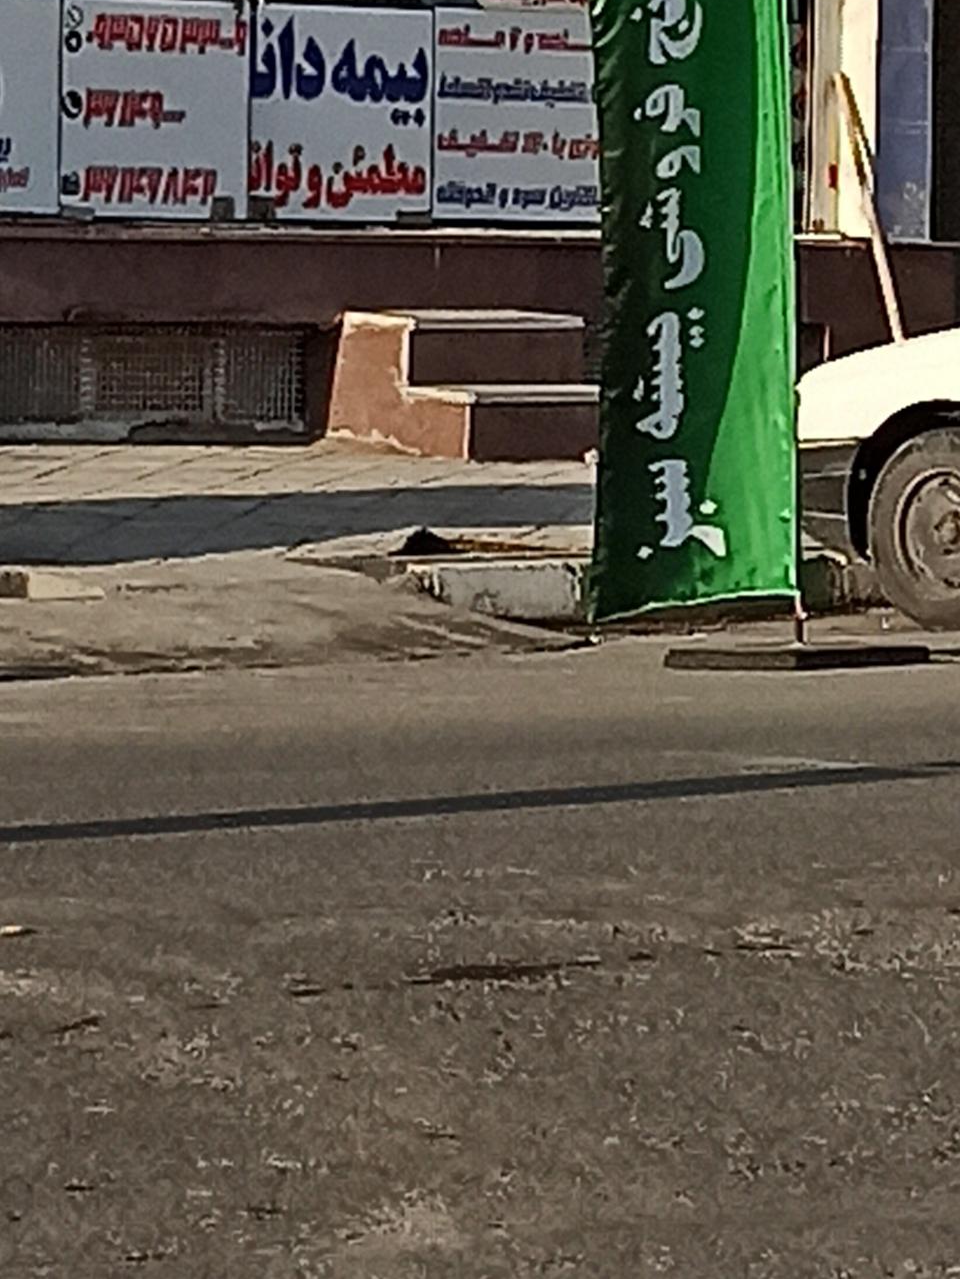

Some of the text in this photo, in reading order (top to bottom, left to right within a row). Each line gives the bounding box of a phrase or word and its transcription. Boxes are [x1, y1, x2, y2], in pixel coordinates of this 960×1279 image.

[331, 38, 429, 128] بیمه
[633, 83, 706, 290] فروشی
[636, 458, 728, 560] سبز
